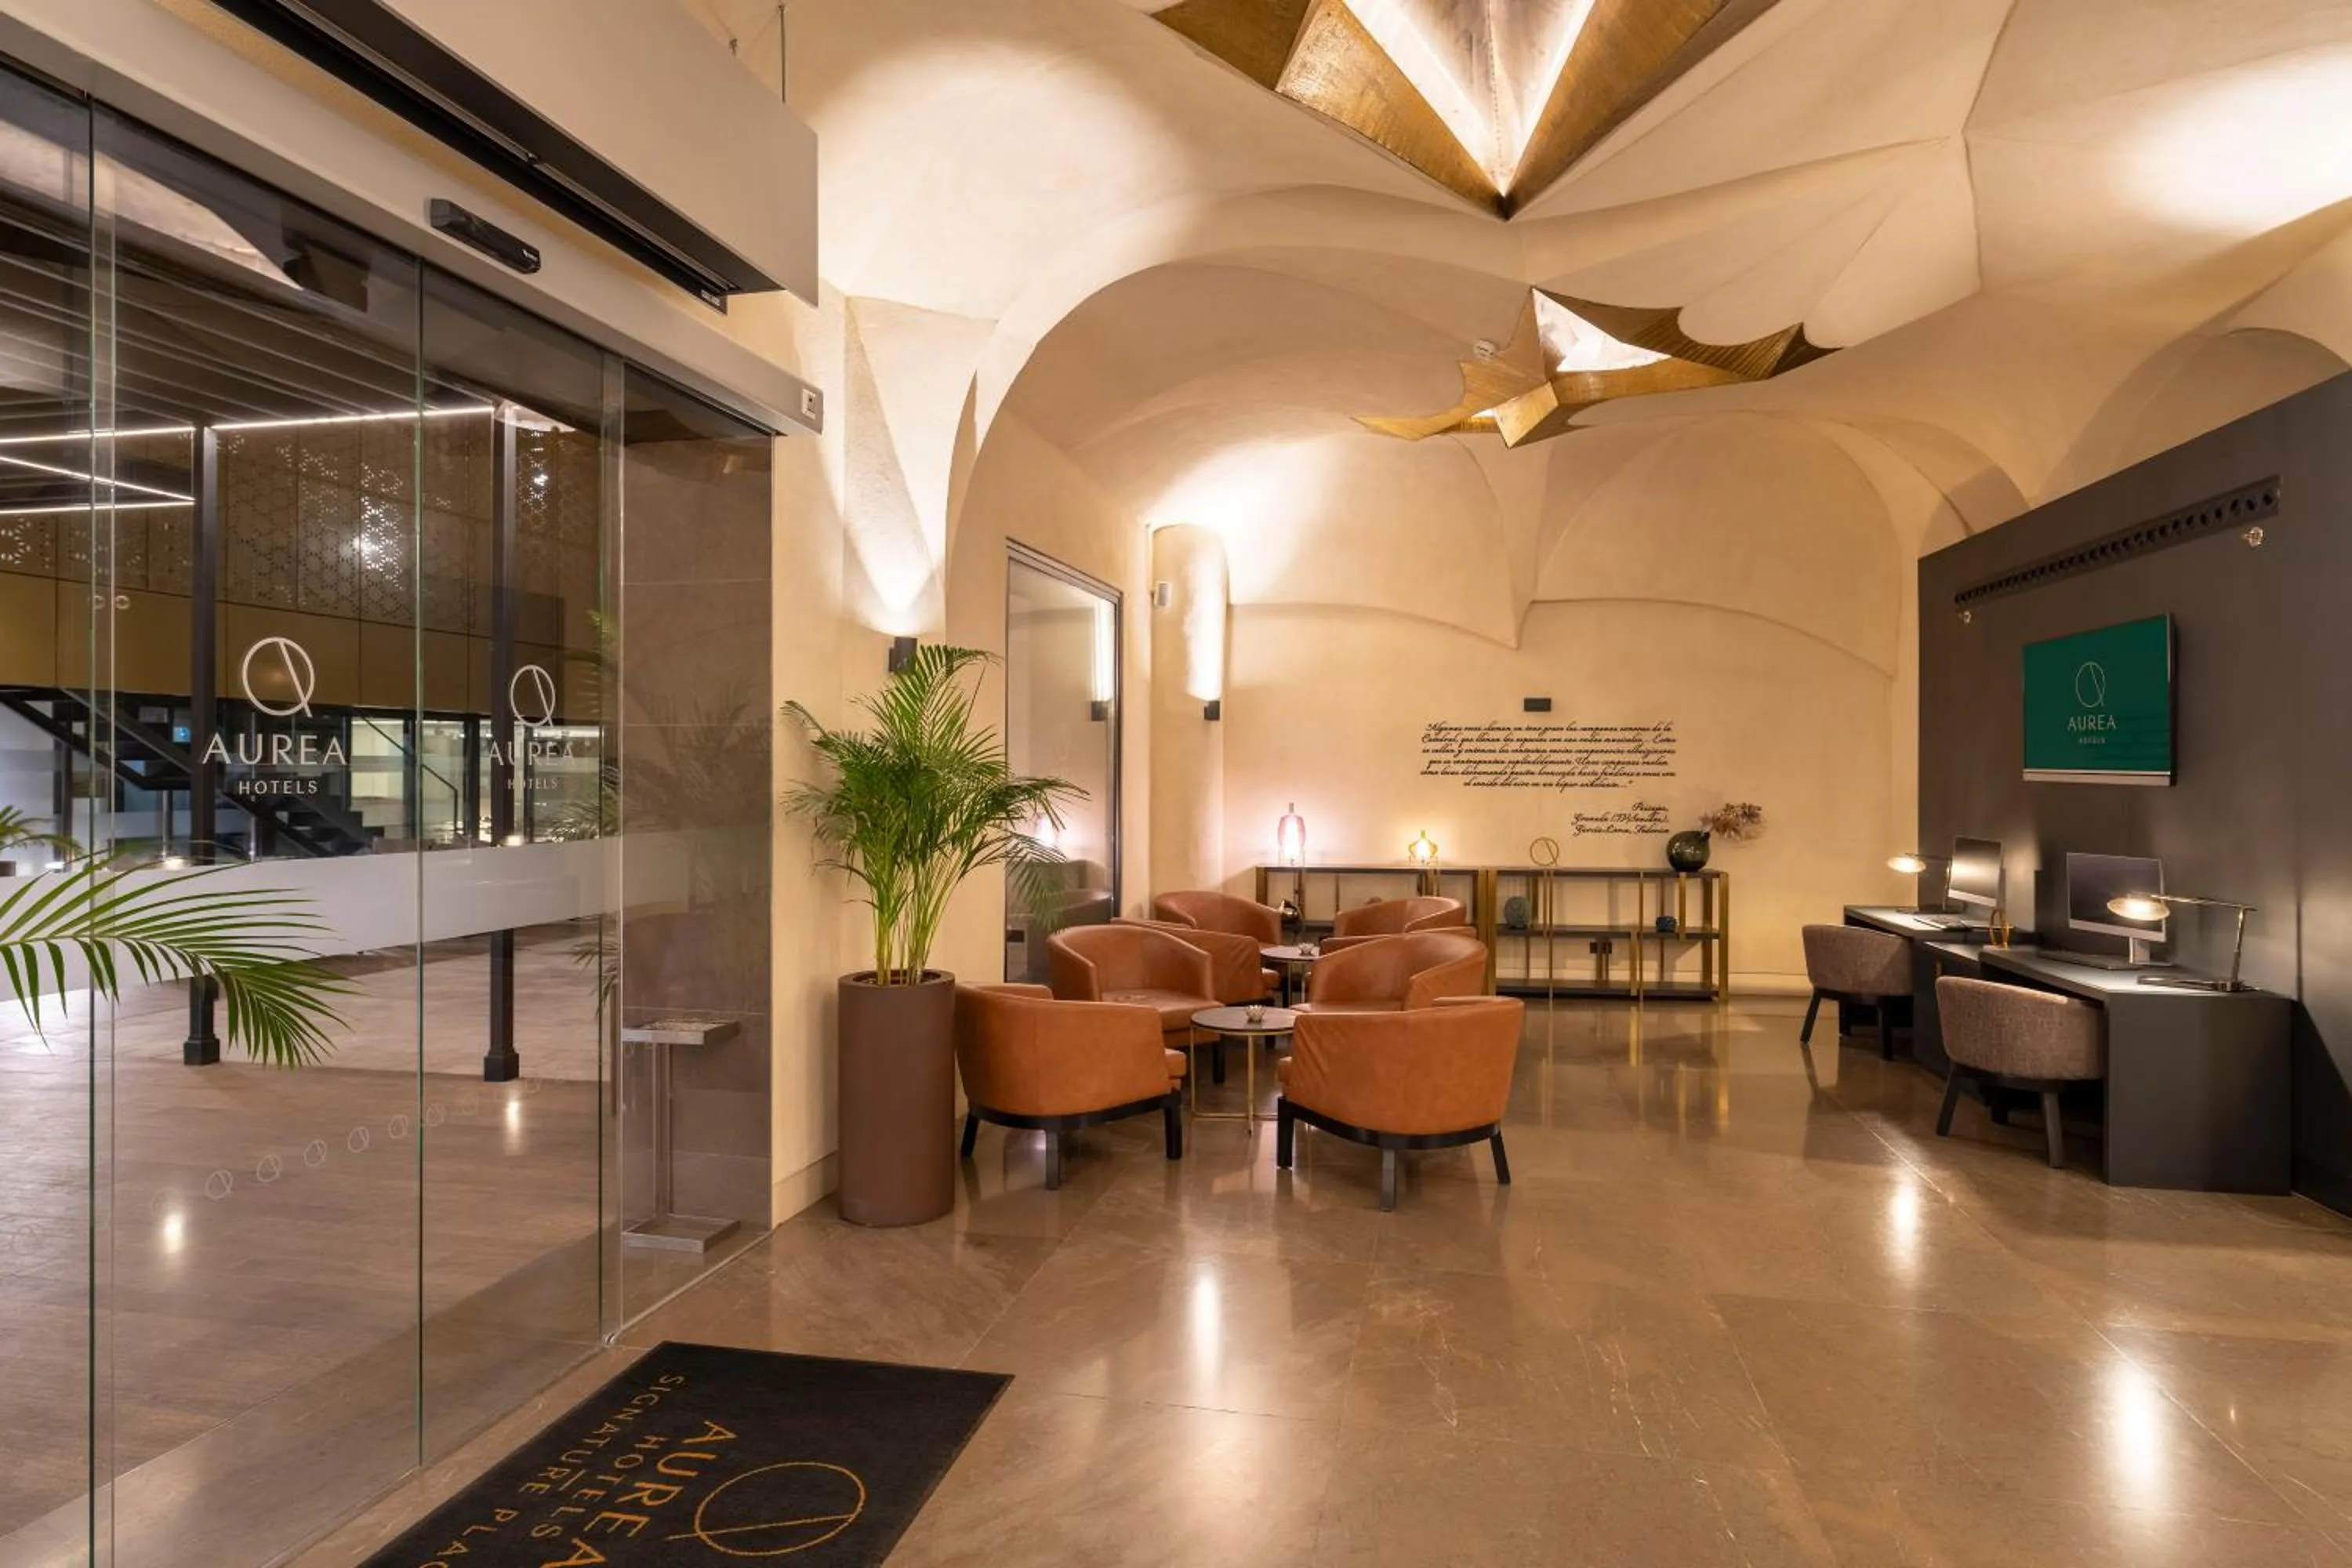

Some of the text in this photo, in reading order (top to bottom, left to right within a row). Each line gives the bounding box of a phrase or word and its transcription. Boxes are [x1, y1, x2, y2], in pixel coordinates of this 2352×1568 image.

[2067, 714, 2116, 732] AUREA
[201, 731, 347, 765] AUREA
[239, 780, 318, 794] HOTELS
[507, 777, 559, 790] HTELS
[519, 1374, 685, 1494] SIGNATURE
[531, 1435, 669, 1537] HOTELS
[539, 1420, 738, 1568] AUREA
